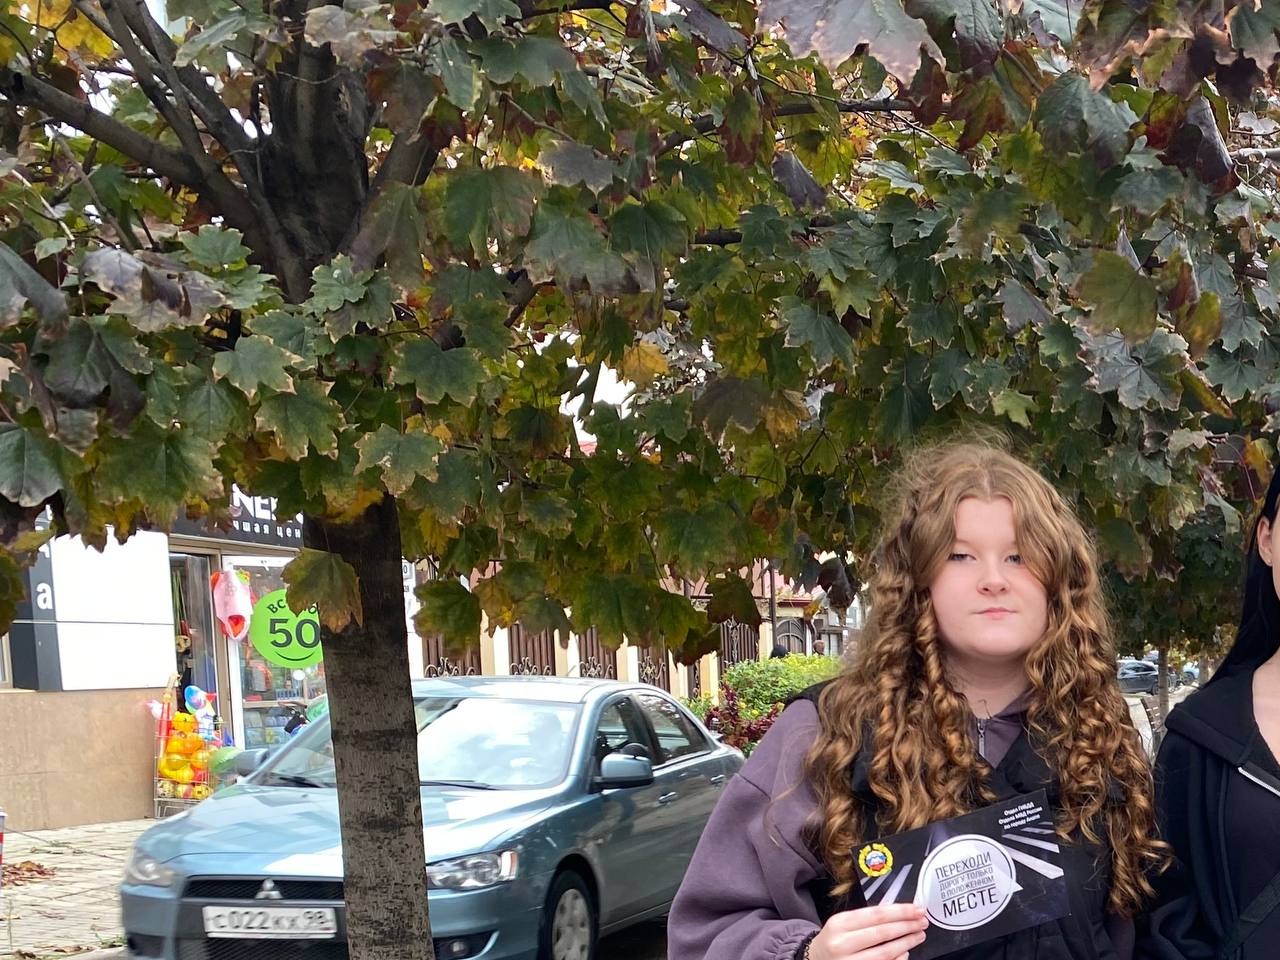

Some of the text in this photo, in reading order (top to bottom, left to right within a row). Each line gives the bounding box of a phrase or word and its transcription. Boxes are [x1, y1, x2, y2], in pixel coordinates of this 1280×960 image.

[277, 524, 302, 539] цен
[269, 618, 321, 649] 50
[935, 851, 992, 880] ПЕРЕХОДИ
[939, 867, 994, 891] ДОРОГУ ТОЛЬКО
[946, 875, 995, 897] ПОЛОЖЕННОМ
[943, 886, 999, 918] МЕСТЕ
